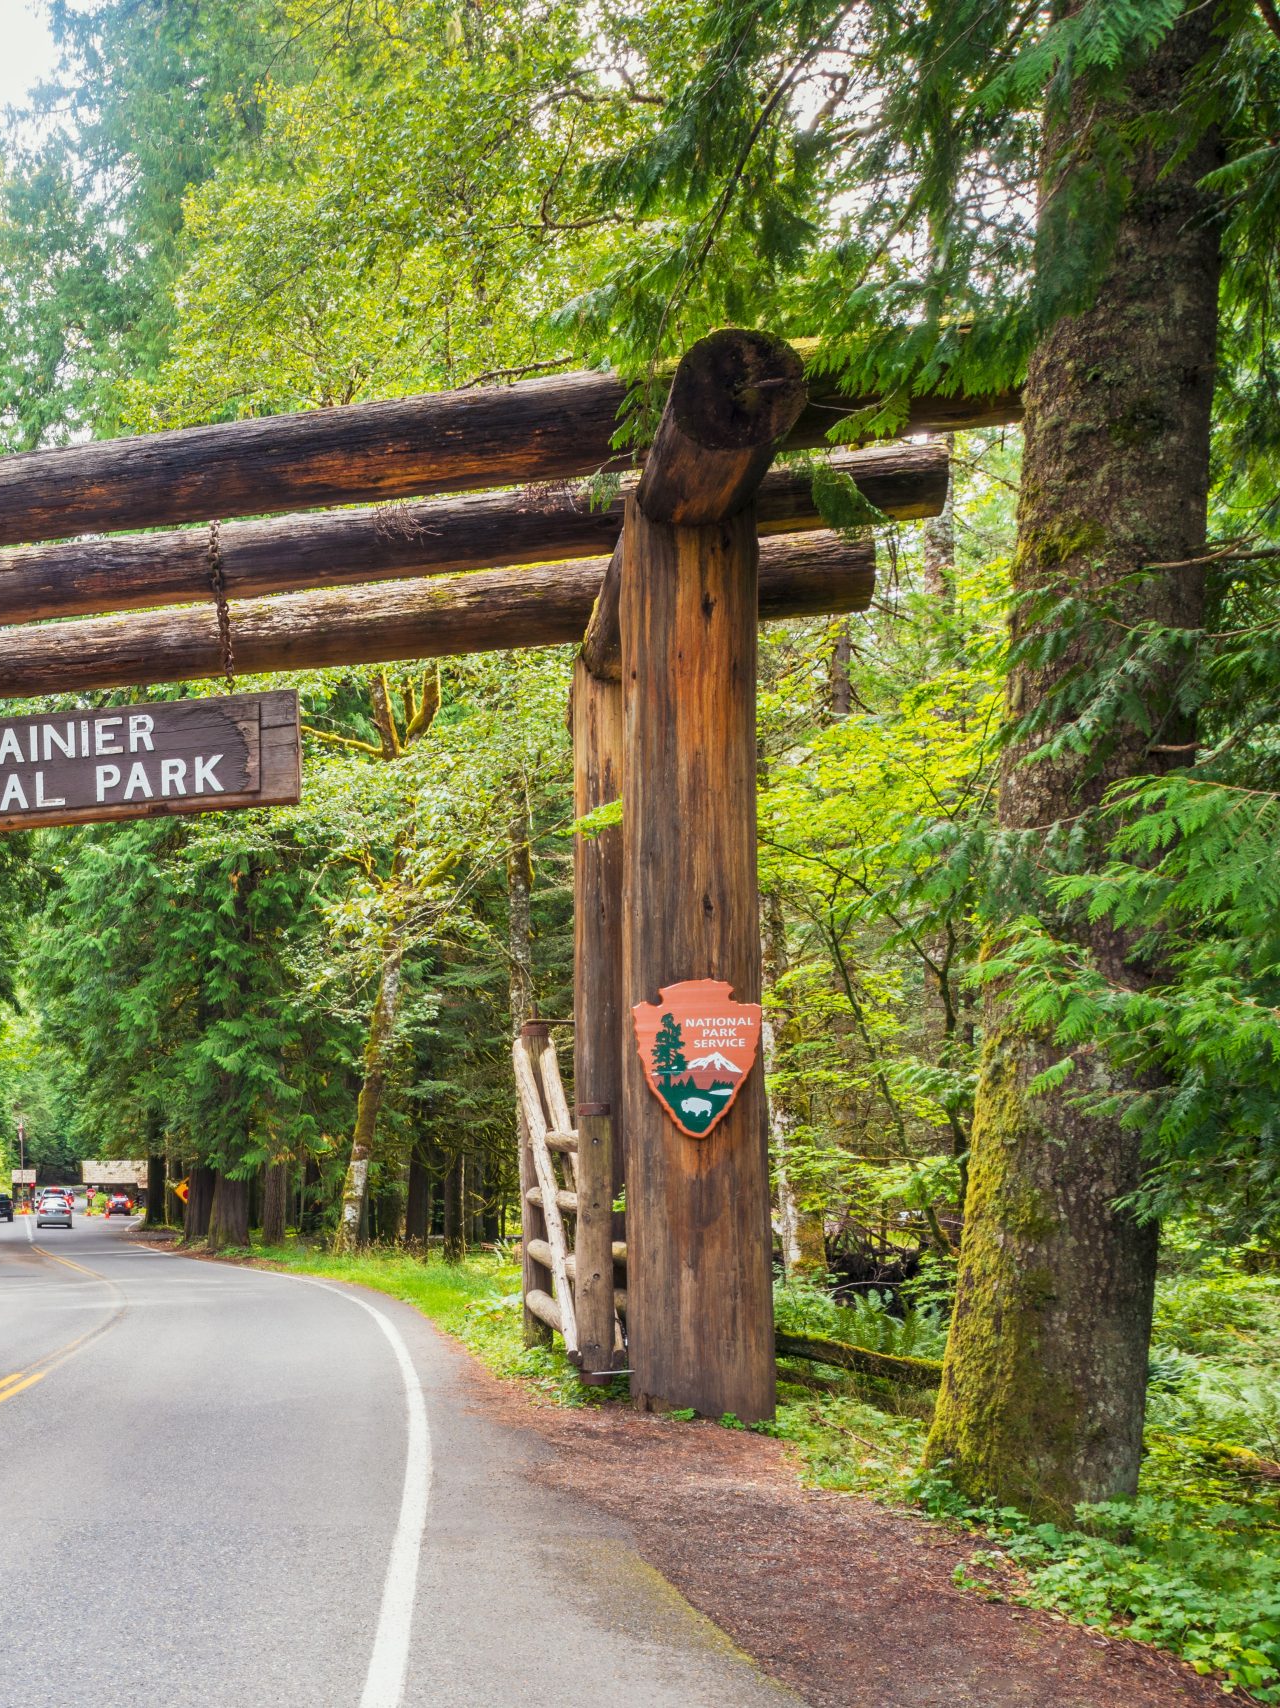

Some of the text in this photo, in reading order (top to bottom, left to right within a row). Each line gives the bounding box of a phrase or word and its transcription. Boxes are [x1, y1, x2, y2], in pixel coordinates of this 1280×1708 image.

[95, 754, 224, 802] PARK
[685, 1017, 754, 1027] NATIONAL
[702, 1028, 736, 1037] PARK
[693, 1038, 746, 1048] SERVICE
